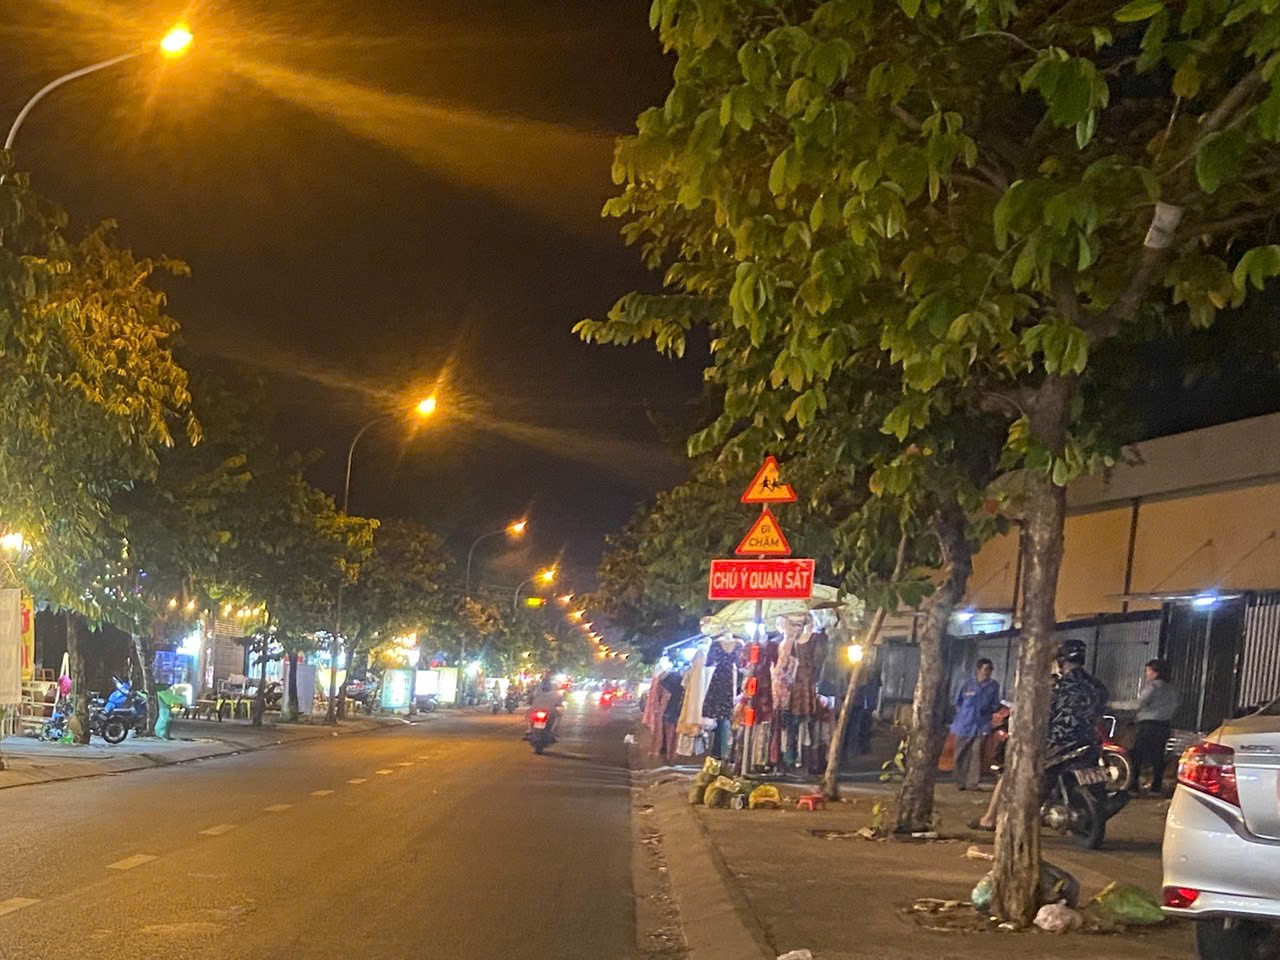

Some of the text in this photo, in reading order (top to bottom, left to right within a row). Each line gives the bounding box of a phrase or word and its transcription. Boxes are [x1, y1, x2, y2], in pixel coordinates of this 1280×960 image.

[760, 524, 771, 534] ĐI
[748, 537, 780, 549] CHẬM
[713, 566, 738, 590] CHÚ
[740, 566, 749, 590] Ý
[749, 570, 783, 590] QUAN
